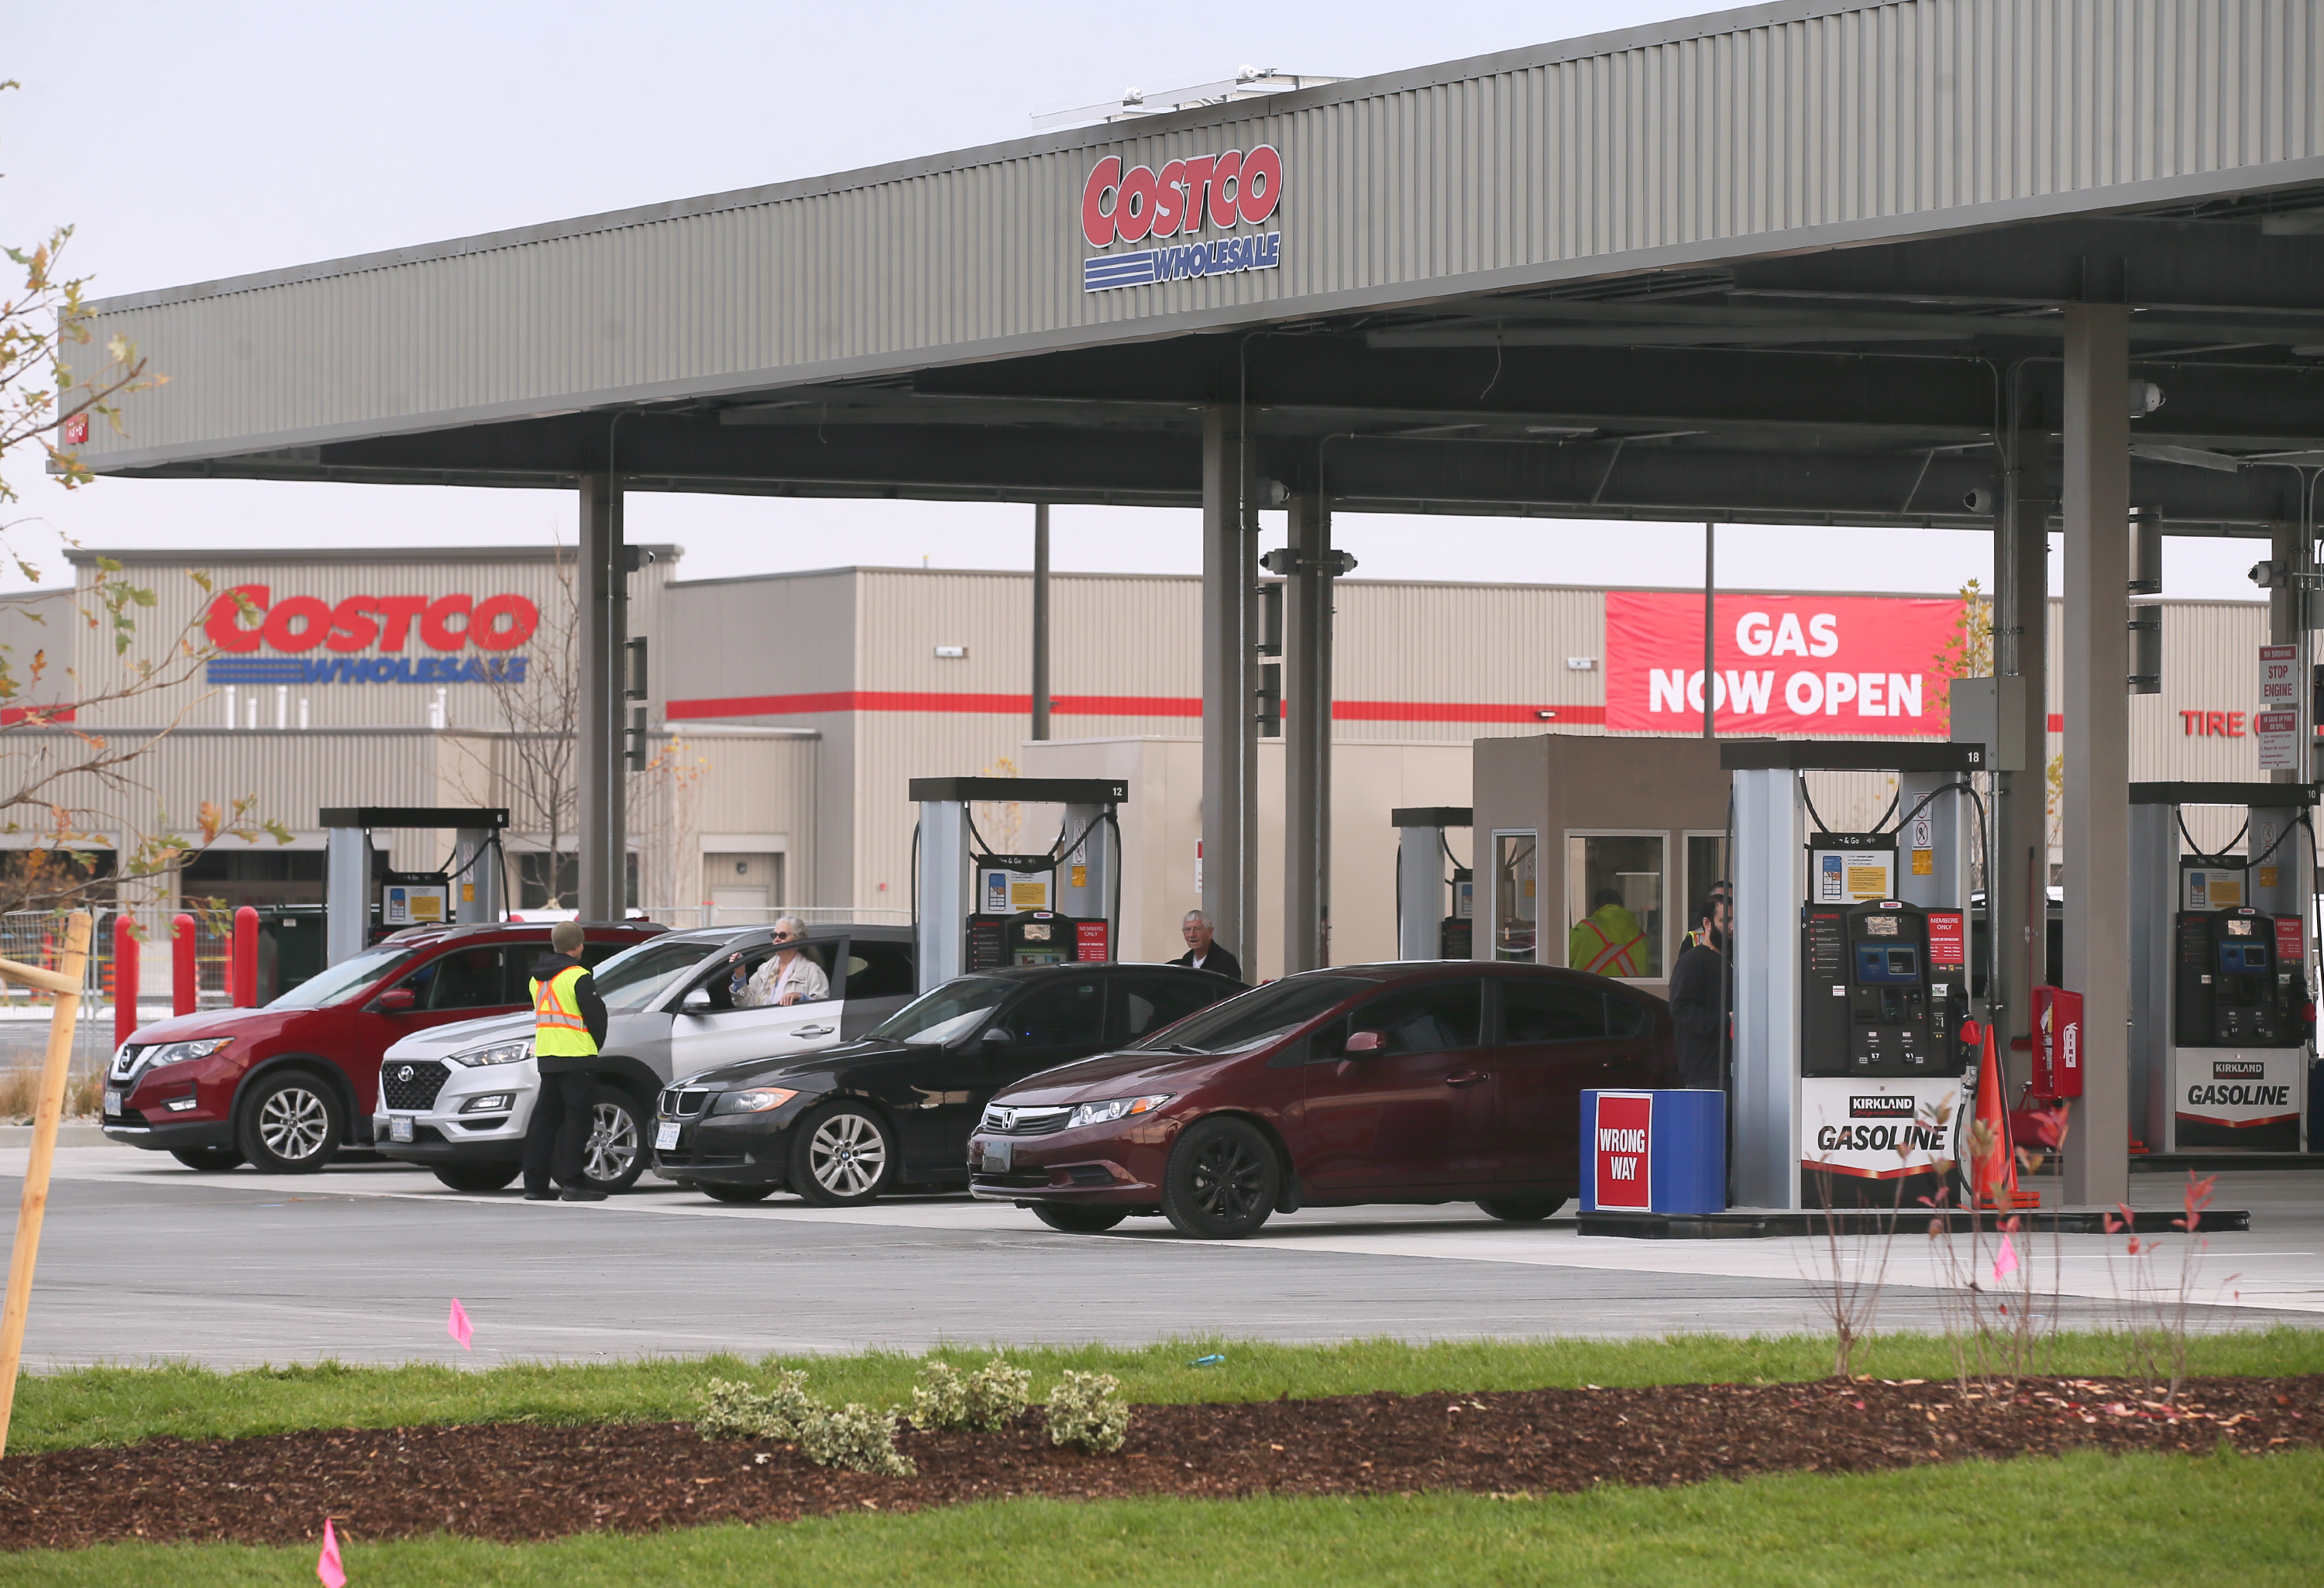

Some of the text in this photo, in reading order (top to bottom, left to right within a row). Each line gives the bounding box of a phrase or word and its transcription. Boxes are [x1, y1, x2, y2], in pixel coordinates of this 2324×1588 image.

[1081, 144, 1283, 249] COSTCO
[1152, 232, 1281, 283] WHOLESALE
[205, 583, 539, 654] COSTCO
[1735, 612, 1839, 658] GAS
[2271, 649, 2291, 658] SMOKING
[2268, 665, 2288, 679] STOP
[1649, 668, 1923, 717] NOW OPEN
[2264, 682, 2292, 697] ENGINE
[2180, 710, 2246, 737] TIRE
[1968, 752, 1979, 762] 18
[1112, 787, 1122, 796] 12
[2216, 1064, 2262, 1072] KIRKLAND
[1853, 1098, 1913, 1109] KIRKLAND
[2188, 1084, 2290, 1105] GASOLINE
[1600, 1128, 1645, 1153] WRONG
[1817, 1126, 1948, 1150] GASOLINE
[1611, 1157, 1637, 1180] WAY
